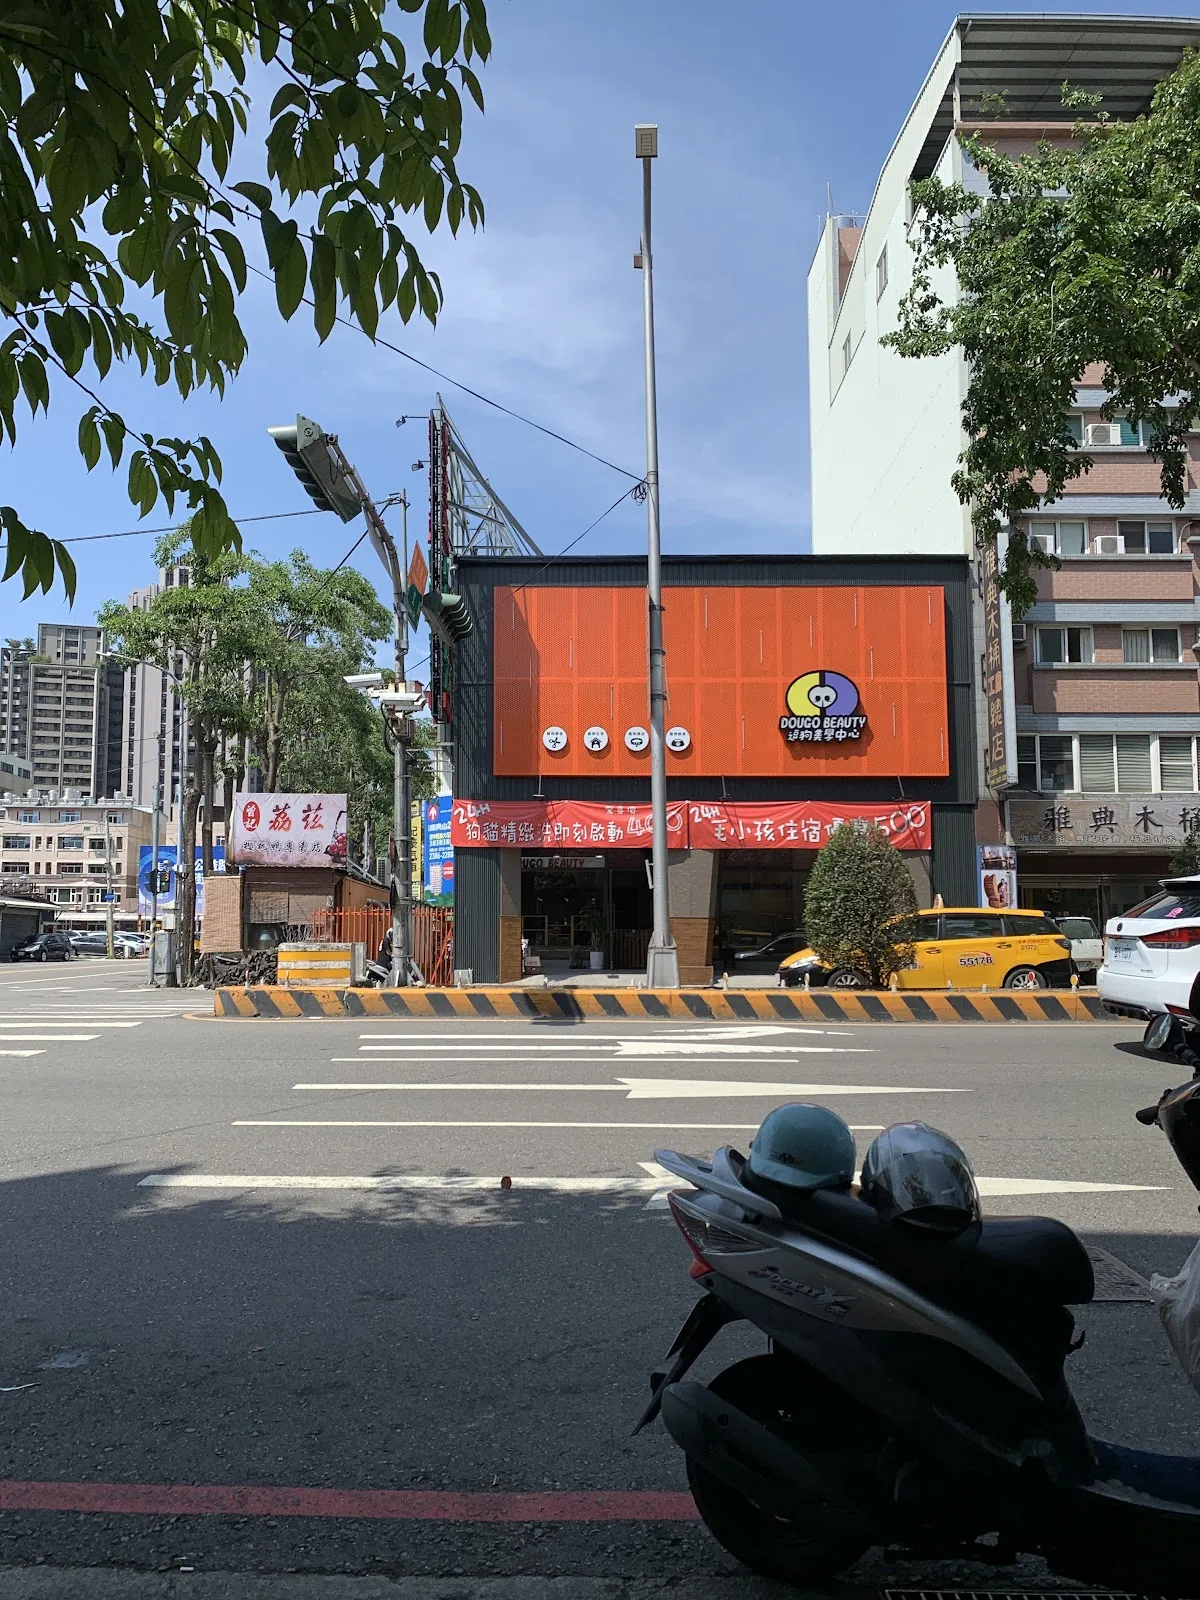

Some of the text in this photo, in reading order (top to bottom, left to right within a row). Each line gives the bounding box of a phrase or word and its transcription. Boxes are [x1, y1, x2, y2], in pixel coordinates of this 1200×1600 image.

[780, 716, 866, 728] DOUGO BEAUTY
[787, 729, 860, 741] 逗狗美學中心
[688, 804, 720, 824] 24H
[521, 858, 585, 869] UGO BEAUTY
[959, 956, 993, 966] 55178
